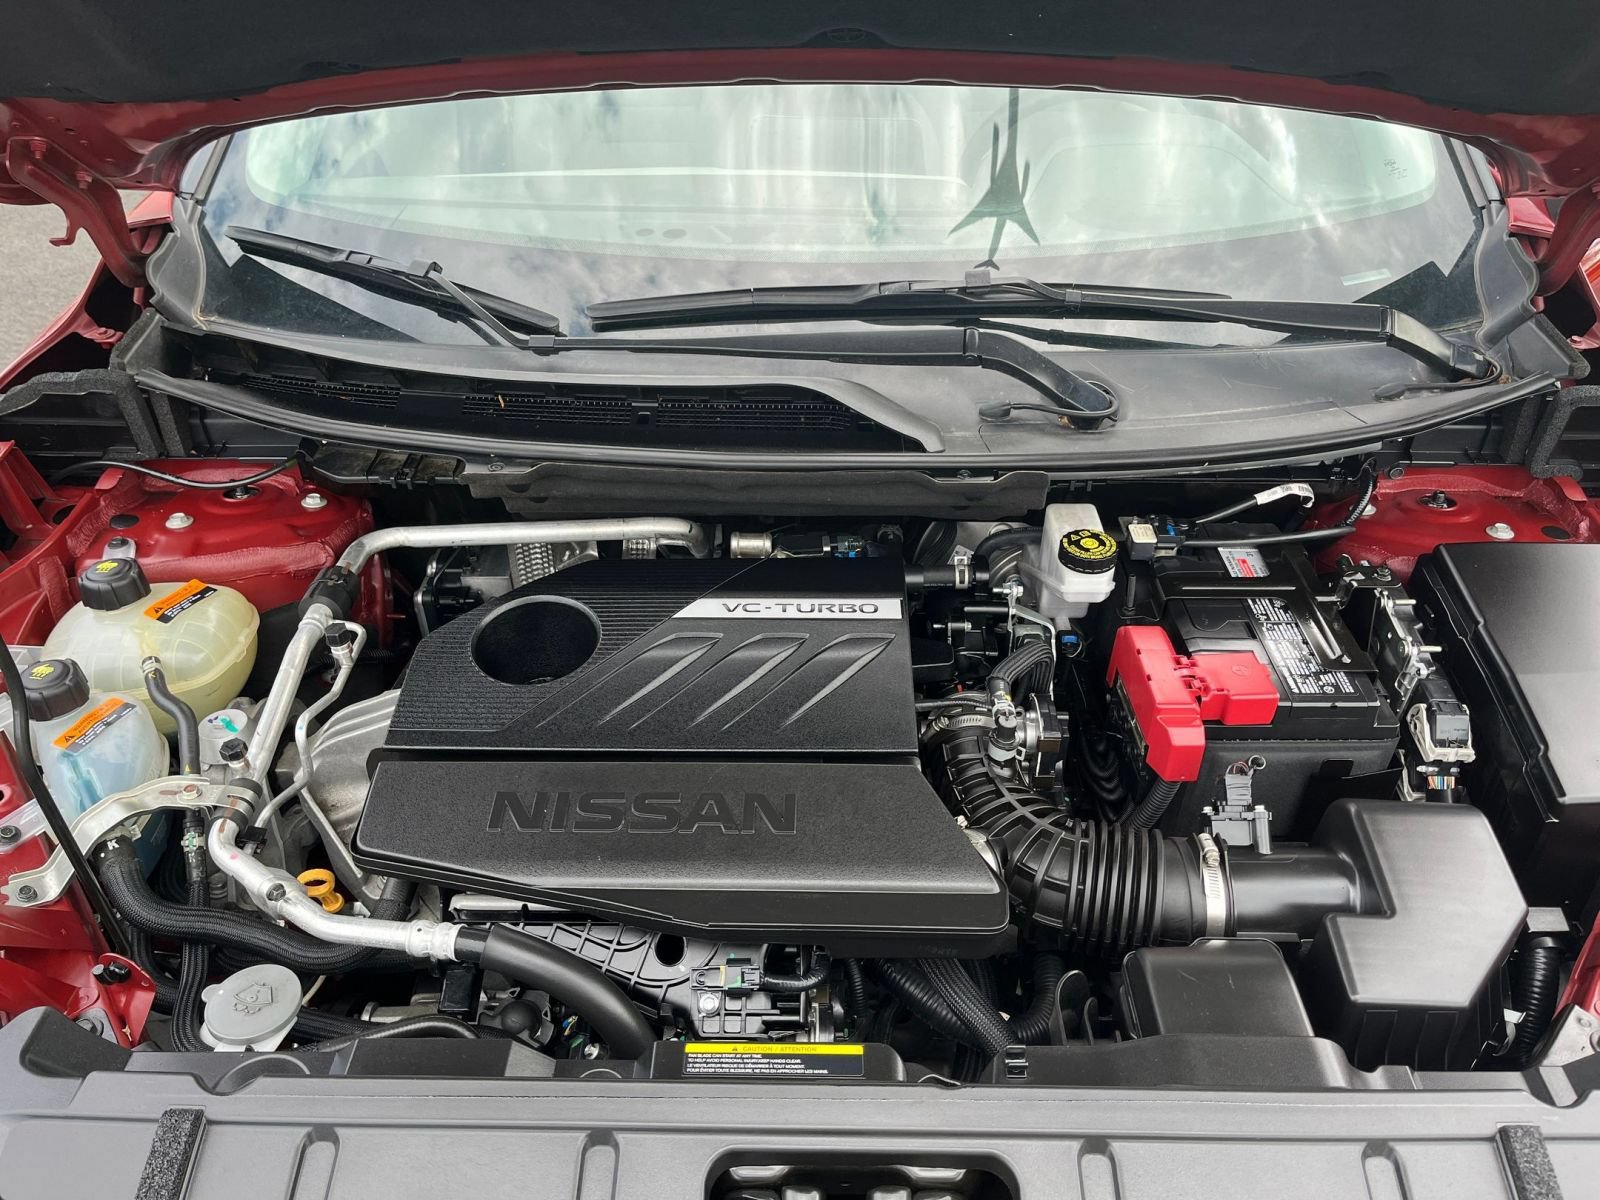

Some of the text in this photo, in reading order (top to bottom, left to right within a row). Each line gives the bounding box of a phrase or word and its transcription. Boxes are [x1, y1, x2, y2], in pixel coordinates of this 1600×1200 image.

[722, 602, 879, 614] VC-TURBO
[487, 790, 797, 835] NISSAN
[107, 838, 120, 851] K
